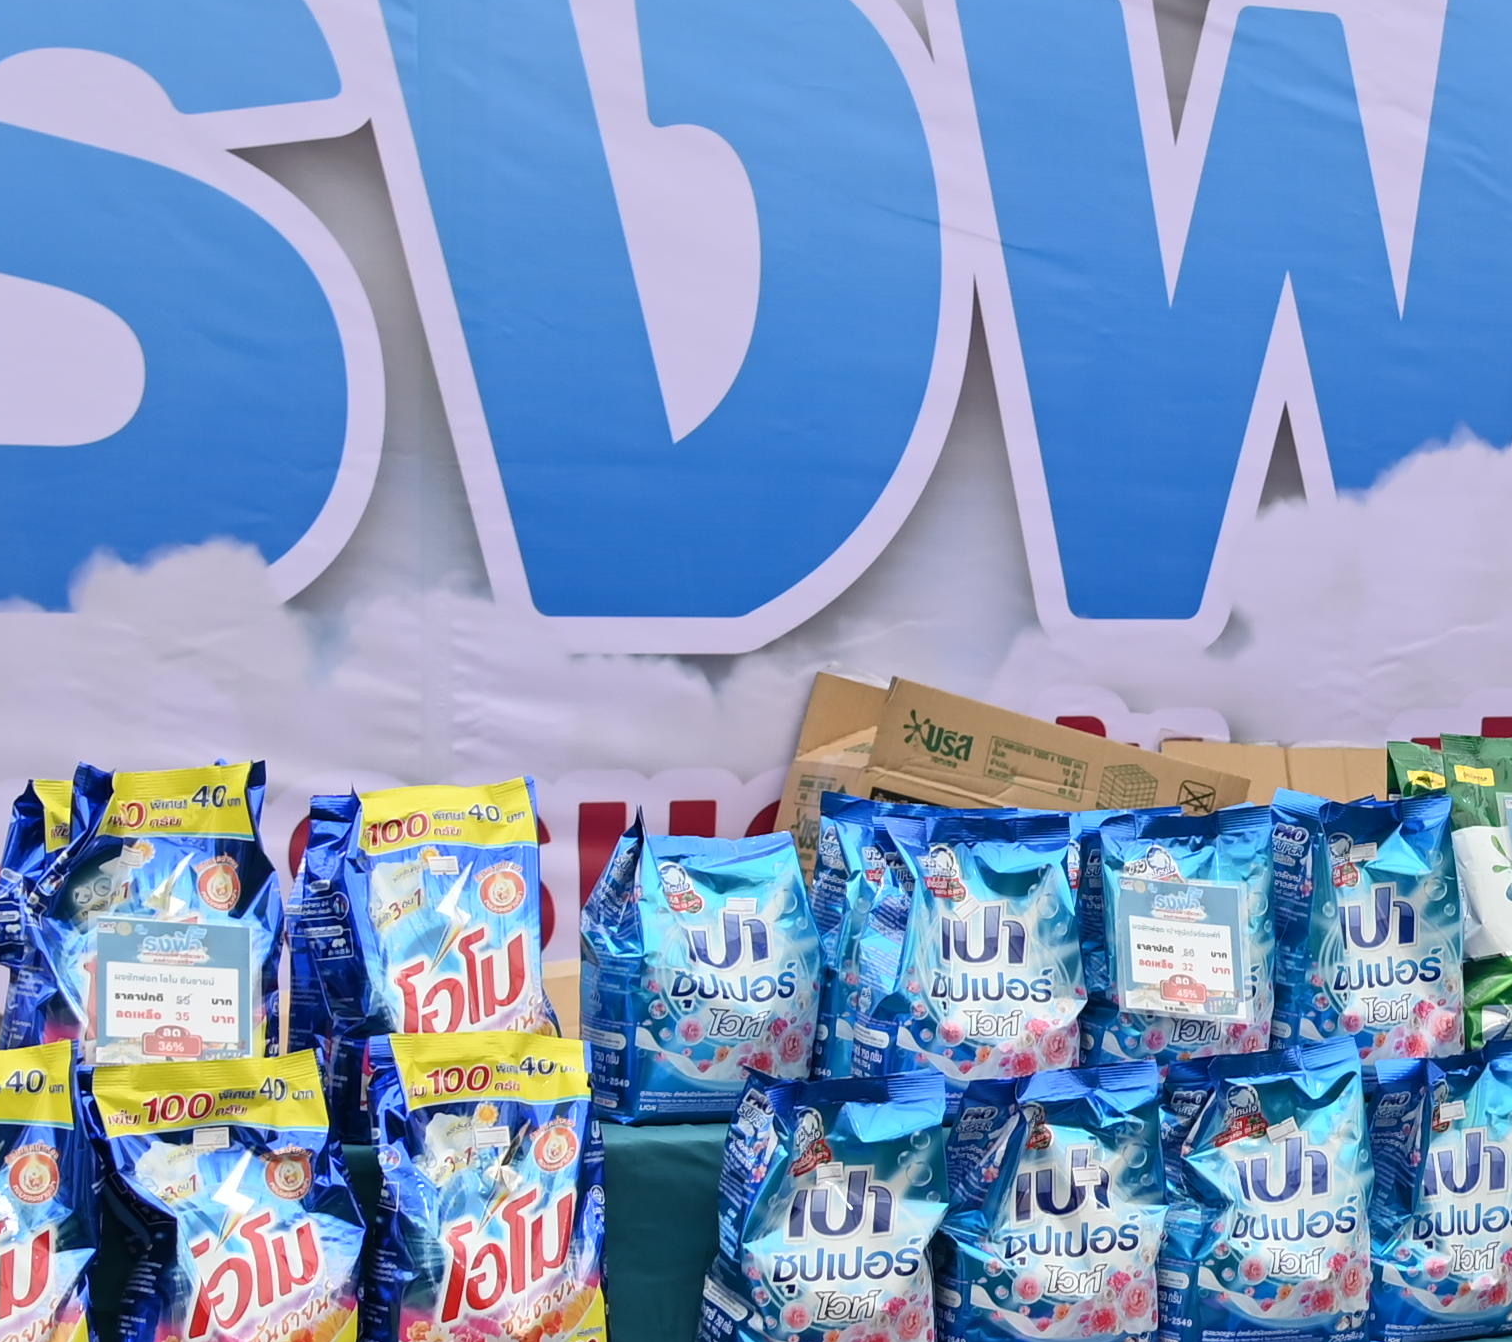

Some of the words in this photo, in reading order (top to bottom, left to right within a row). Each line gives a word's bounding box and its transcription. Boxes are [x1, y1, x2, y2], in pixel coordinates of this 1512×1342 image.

[941, 905, 1029, 963] เปา
[1182, 962, 1194, 971] 32
[1211, 966, 1231, 975] บาท
[1210, 950, 1228, 959] บาท
[114, 991, 164, 1003] ราคาปกติ
[211, 997, 233, 1006] บาท
[931, 966, 1054, 1013] ซุปเปอร์
[1176, 989, 1198, 999] 45%
[115, 1008, 162, 1020] ลดเหลือ
[175, 1012, 190, 1022] 35
[211, 1014, 235, 1024] บาท
[163, 1028, 181, 1038] ลด
[962, 1006, 1025, 1039] ไวท์
[158, 1041, 185, 1052] 36%
[142, 1090, 215, 1122] 100
[259, 1076, 288, 1103] 40
[1238, 1133, 1331, 1203] เปา
[785, 1167, 897, 1240] เปา
[1230, 1194, 1359, 1251] ซุปเปอร์
[442, 1189, 574, 1323] โอโม
[1004, 1213, 1142, 1266] ซุปเปอร์
[189, 1211, 320, 1339] โอโม
[772, 1235, 925, 1294] ซุปเปอร์
[1044, 1264, 1108, 1296] ไวท์
[815, 1289, 882, 1321] ไวท์
